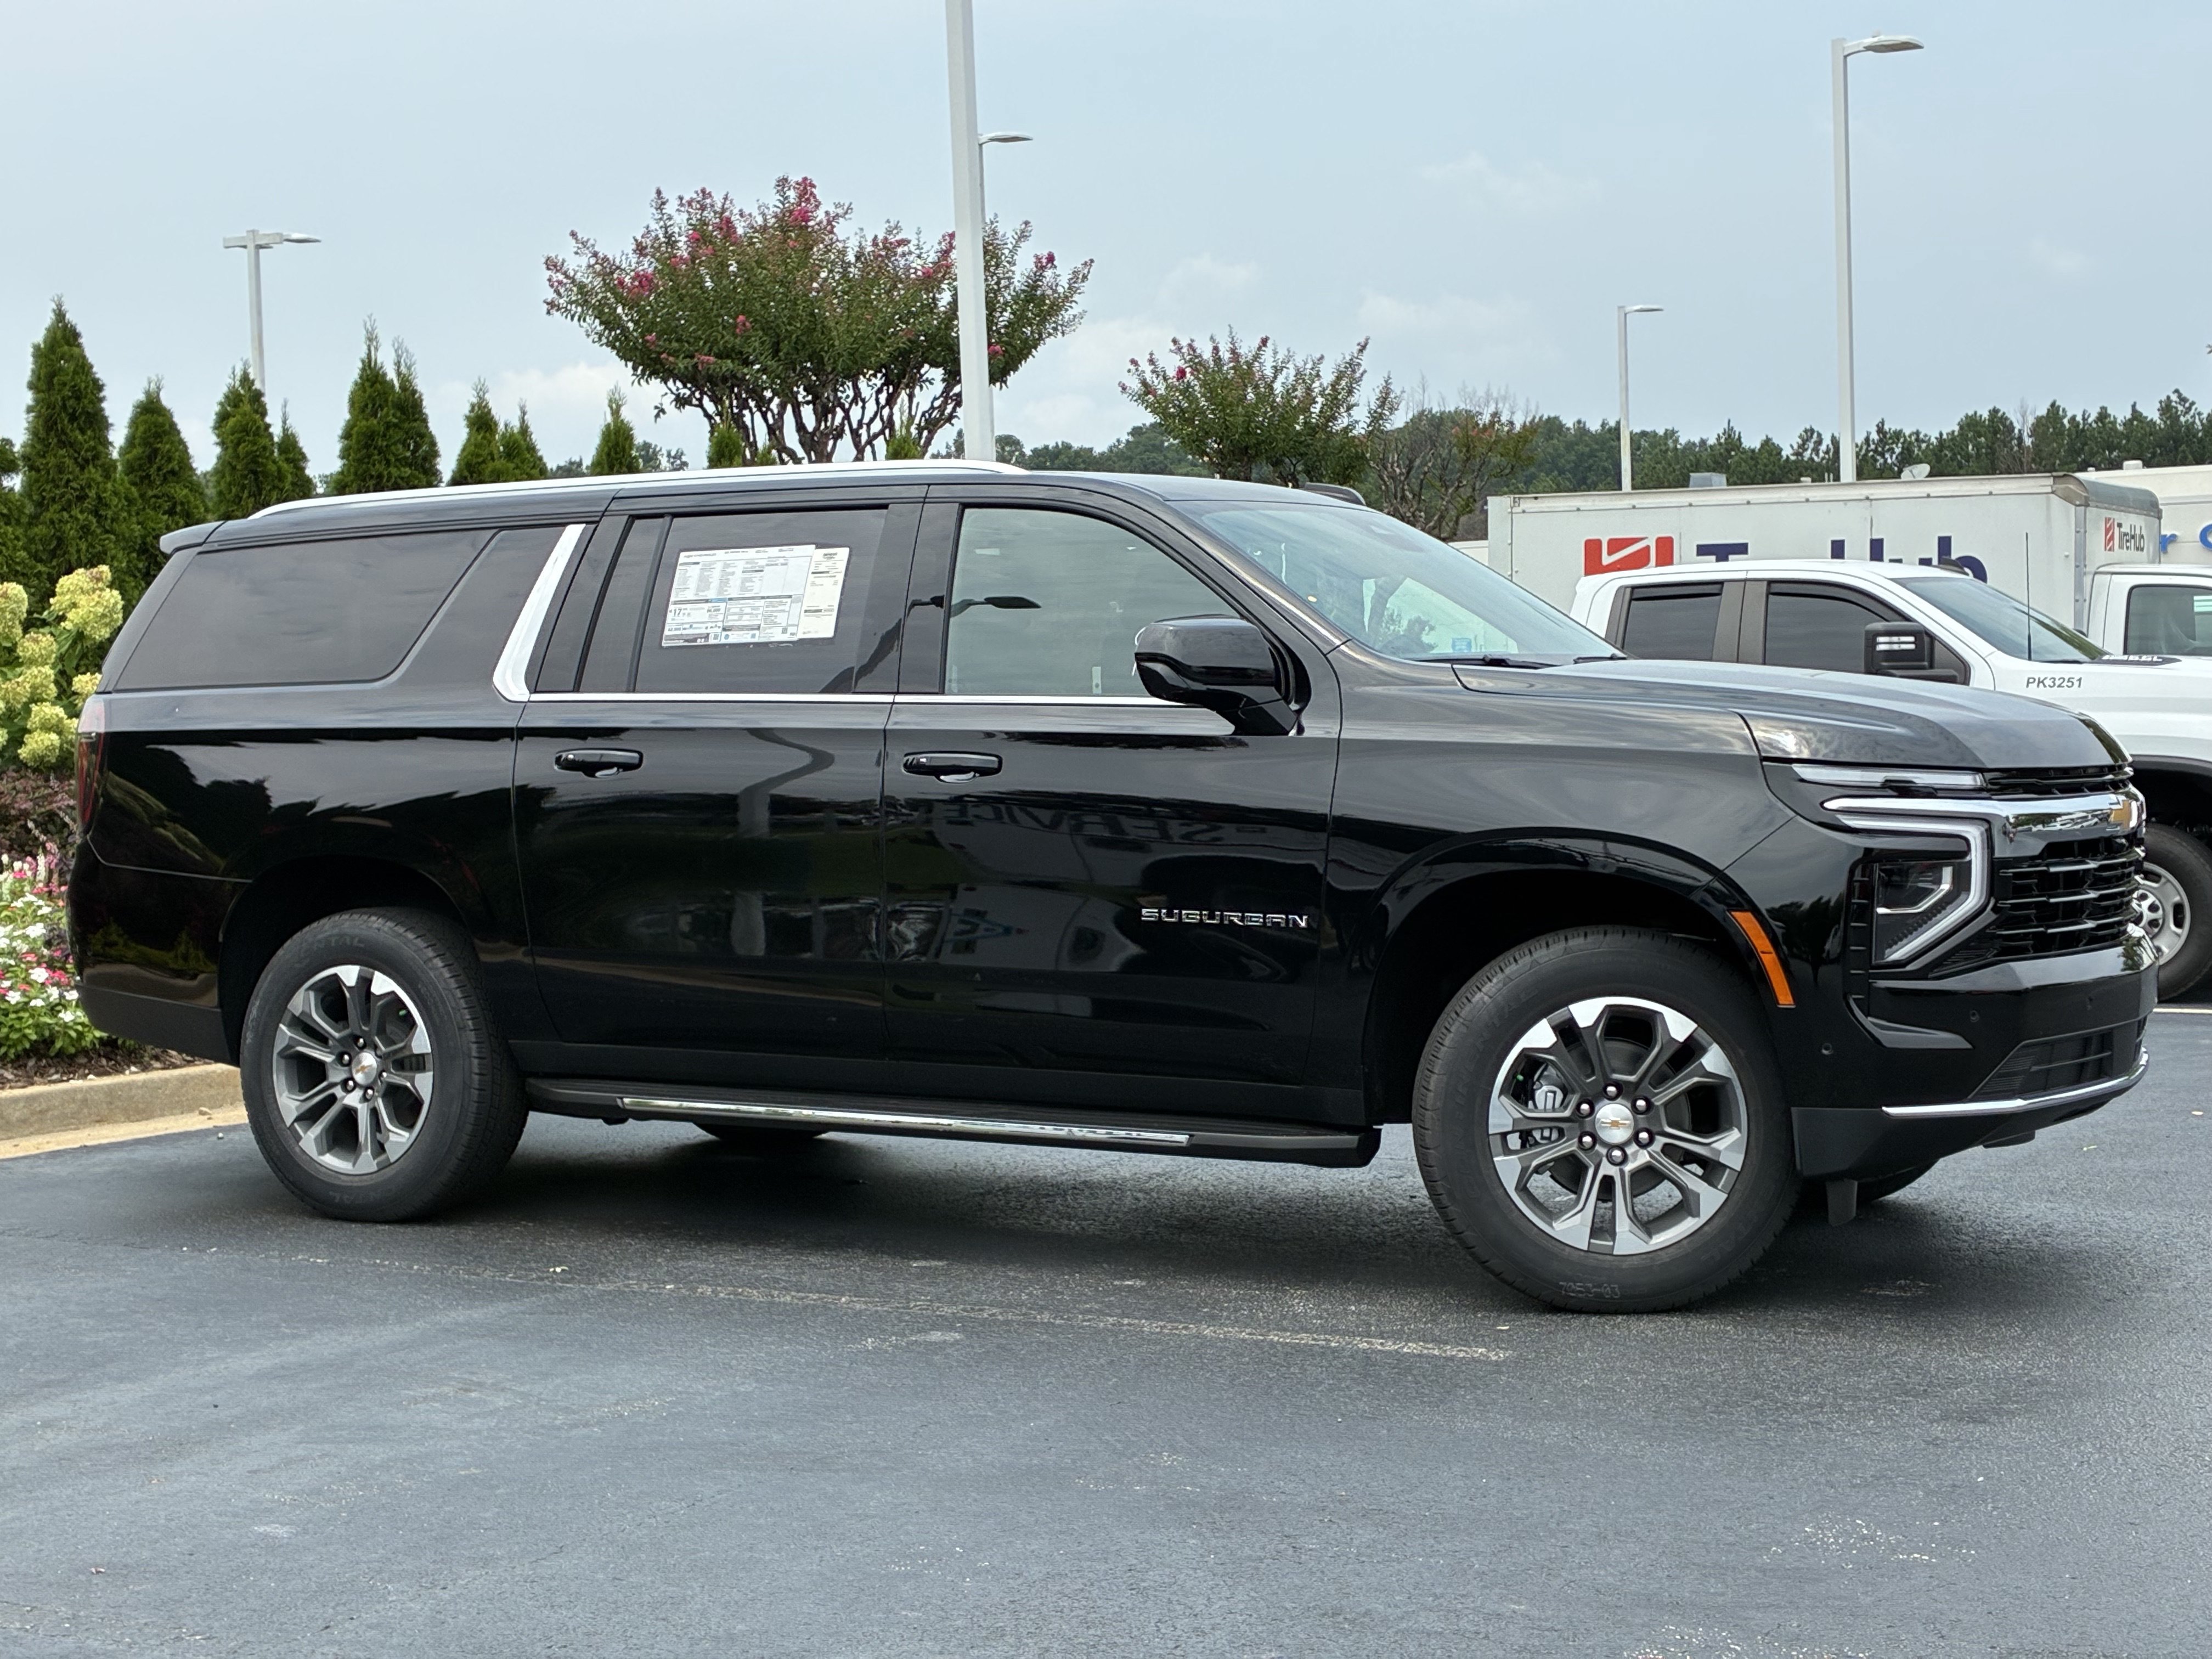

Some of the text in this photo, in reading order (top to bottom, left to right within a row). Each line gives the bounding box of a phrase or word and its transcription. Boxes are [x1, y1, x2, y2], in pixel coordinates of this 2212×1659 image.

[2117, 522, 2145, 552] TireHub
[2025, 676, 2083, 689] PK3251
[1141, 908, 1309, 928] SUBURBAN
